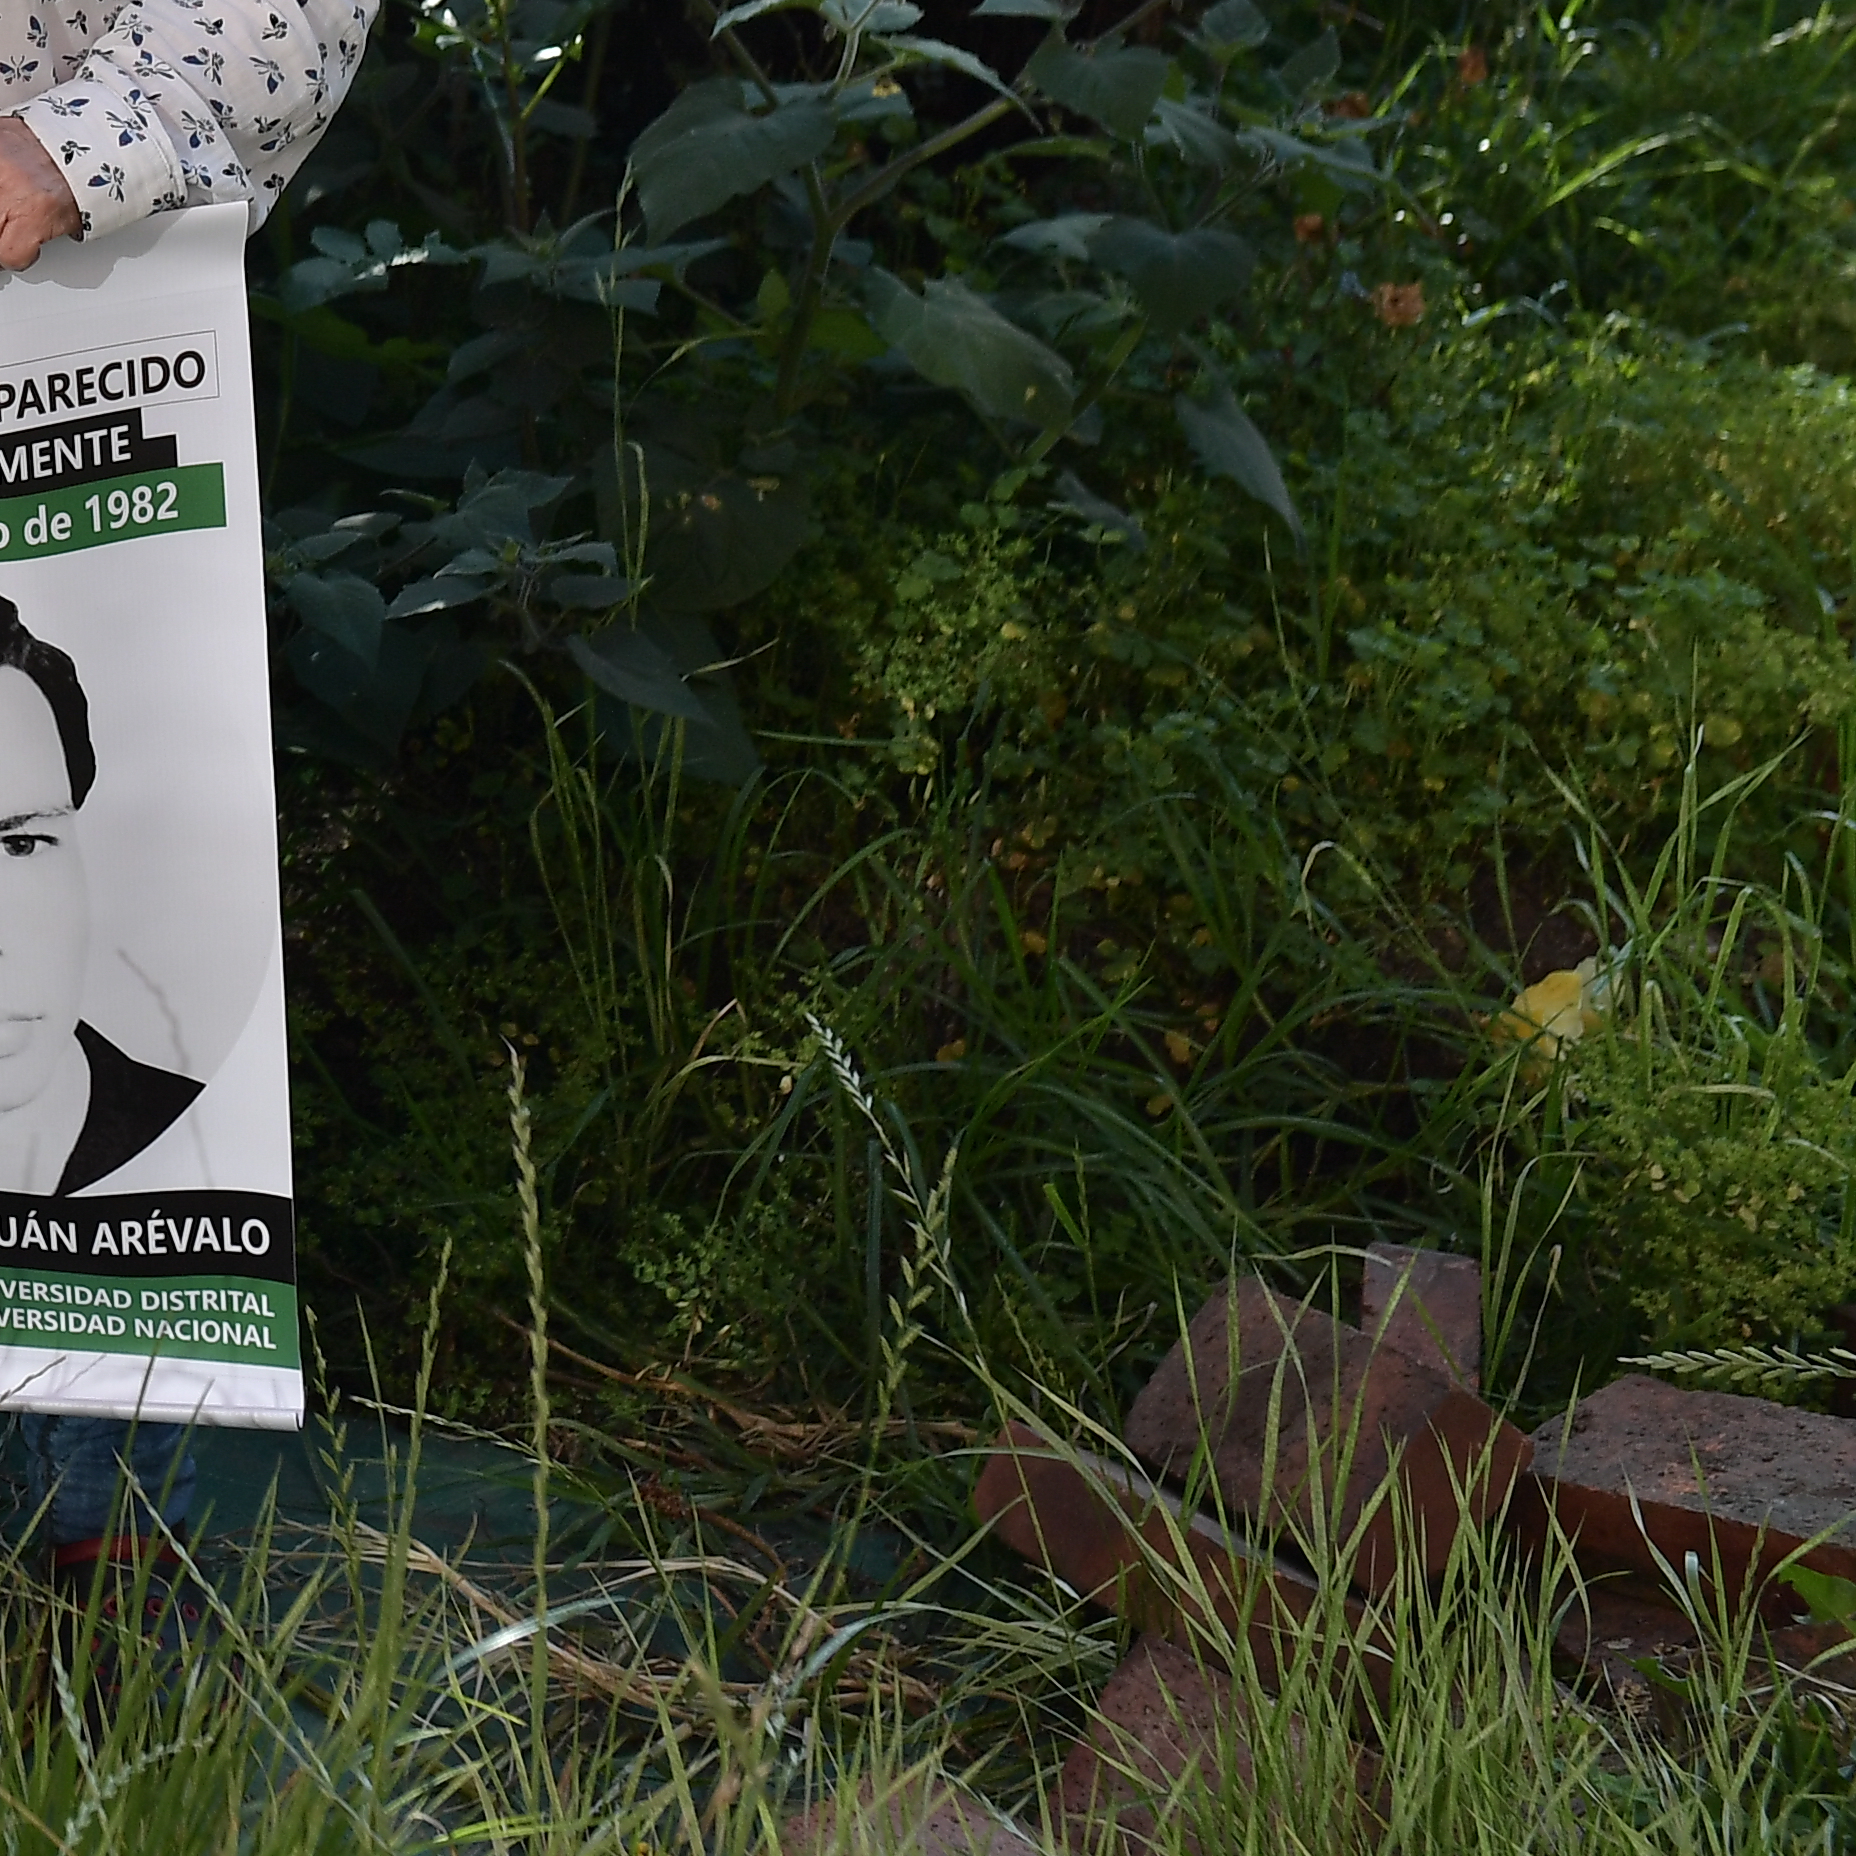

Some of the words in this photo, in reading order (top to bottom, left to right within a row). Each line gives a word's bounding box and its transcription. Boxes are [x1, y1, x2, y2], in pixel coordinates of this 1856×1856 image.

[23, 503, 73, 544] de
[84, 481, 180, 532] 1982
[91, 1210, 272, 1257] ARÉVALO
[141, 1289, 276, 1318] DISTRITAL
[134, 1317, 277, 1349] NACIONAL
